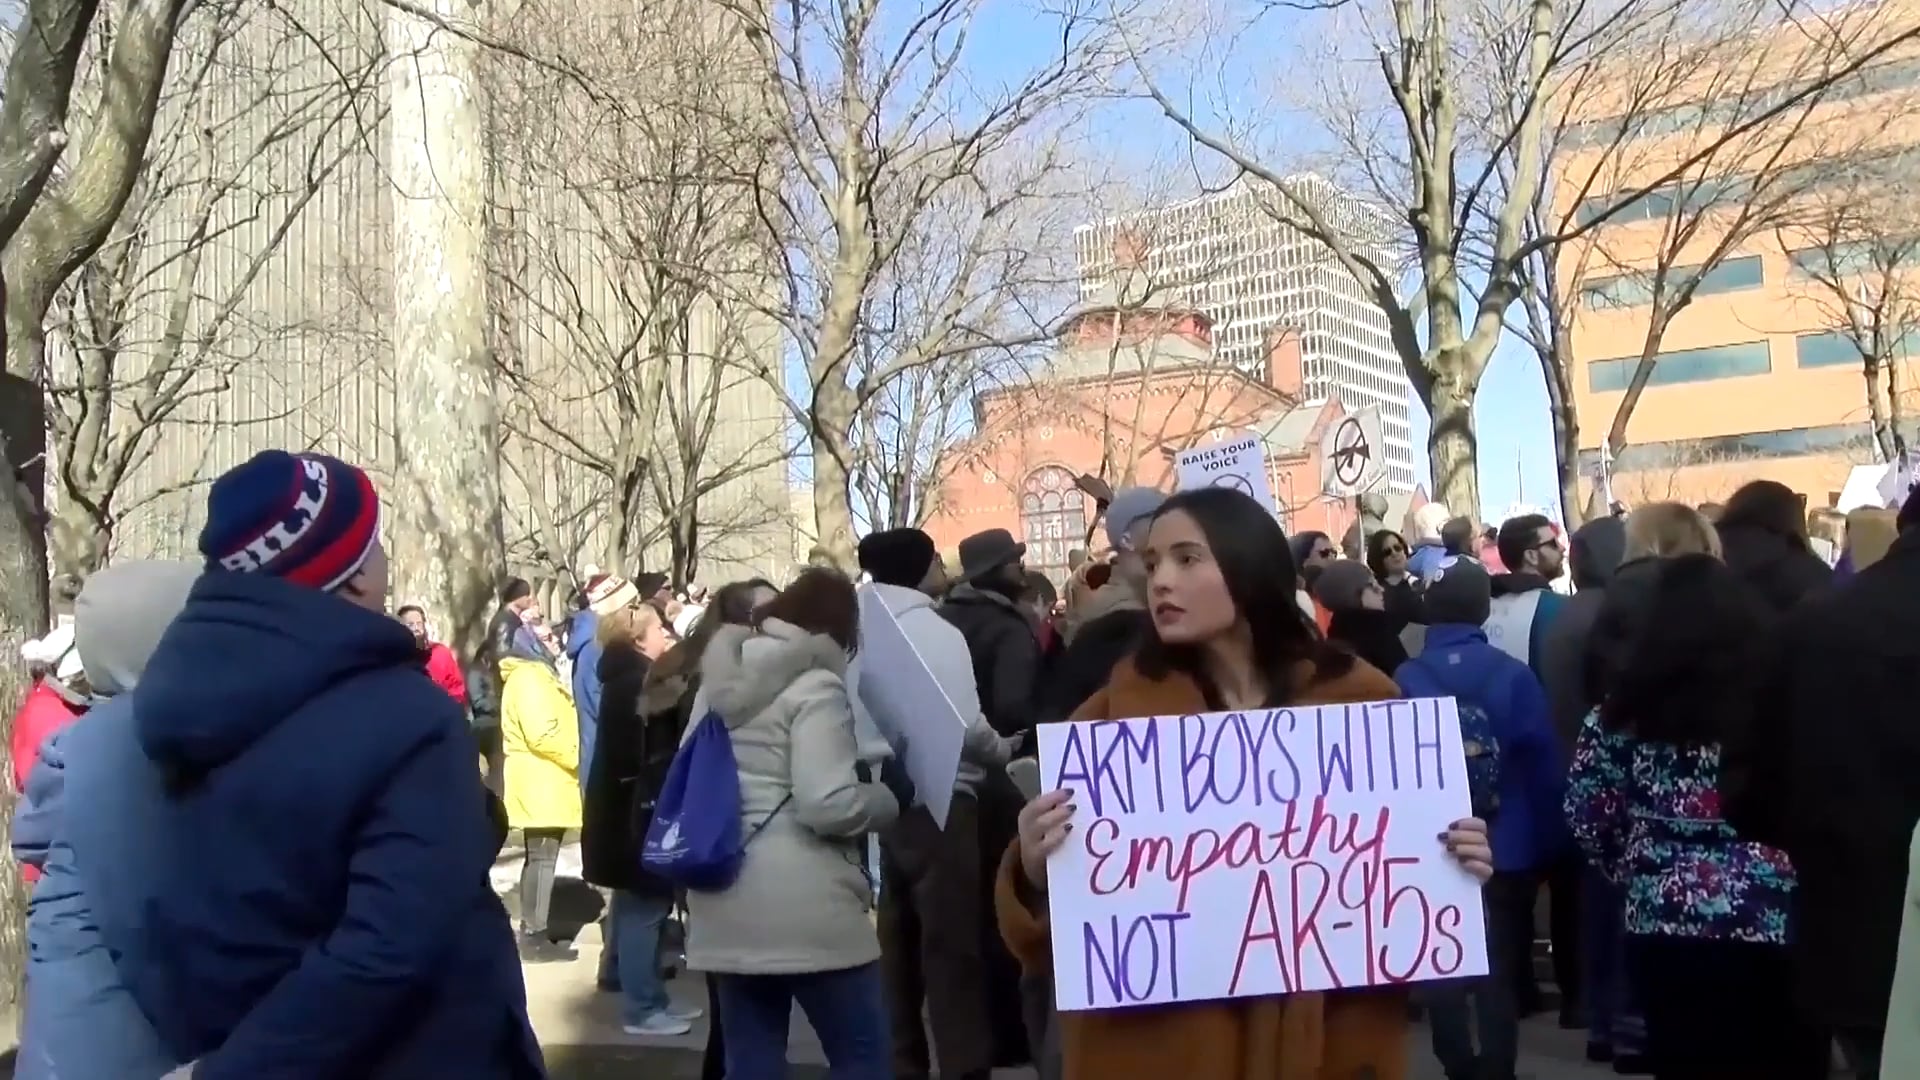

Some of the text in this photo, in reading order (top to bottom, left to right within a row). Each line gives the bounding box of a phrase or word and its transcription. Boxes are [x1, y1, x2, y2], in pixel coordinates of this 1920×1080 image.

[1182, 439, 1256, 466] RAISE YOUR
[1202, 455, 1239, 472] VOICE
[219, 459, 329, 574] BILLS
[1056, 699, 1445, 817] ARM BOYS WITH
[1085, 794, 1390, 913] Empathy
[1083, 857, 1464, 1006] NOT AR-15s
